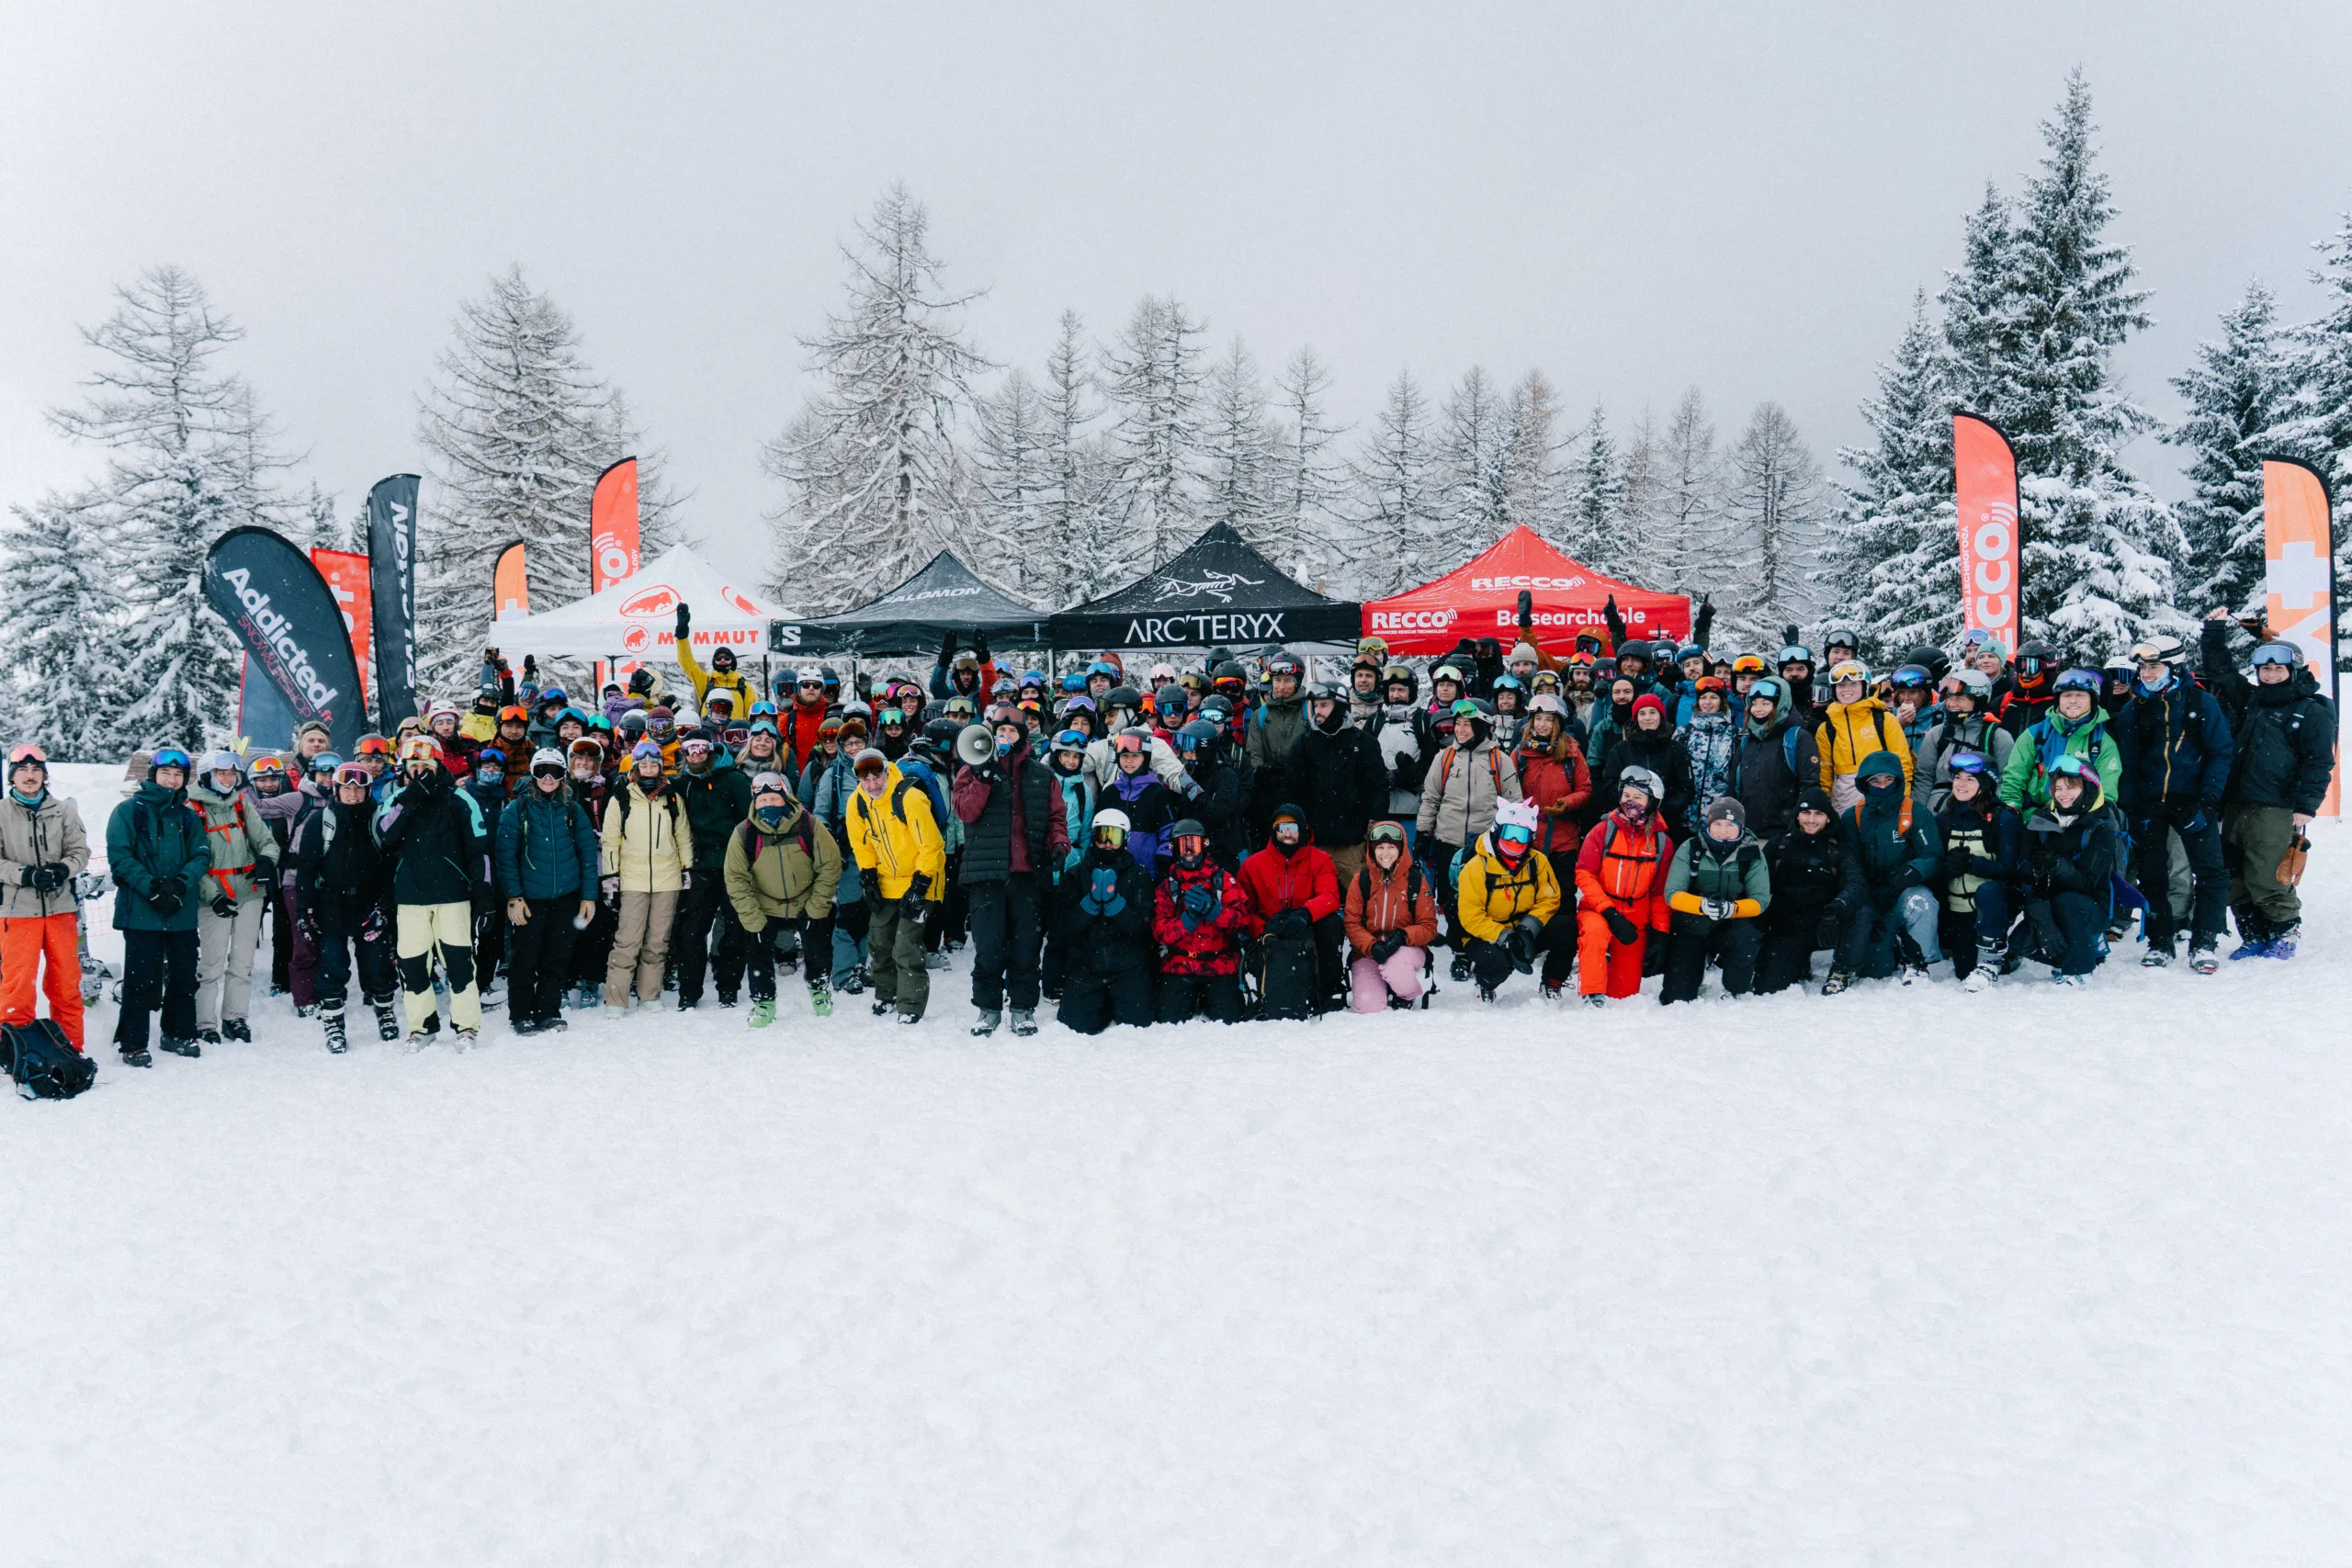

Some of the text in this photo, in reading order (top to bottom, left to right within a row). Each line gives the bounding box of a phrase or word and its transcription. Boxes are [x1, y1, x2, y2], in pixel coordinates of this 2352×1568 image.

[1471, 576, 1574, 588] RECCO
[878, 587, 982, 604] SALOMON
[1125, 613, 1285, 643] ARC'TERYX
[1372, 611, 1449, 629] RECCO
[658, 630, 759, 645] MMMUT
[782, 626, 802, 646] S
